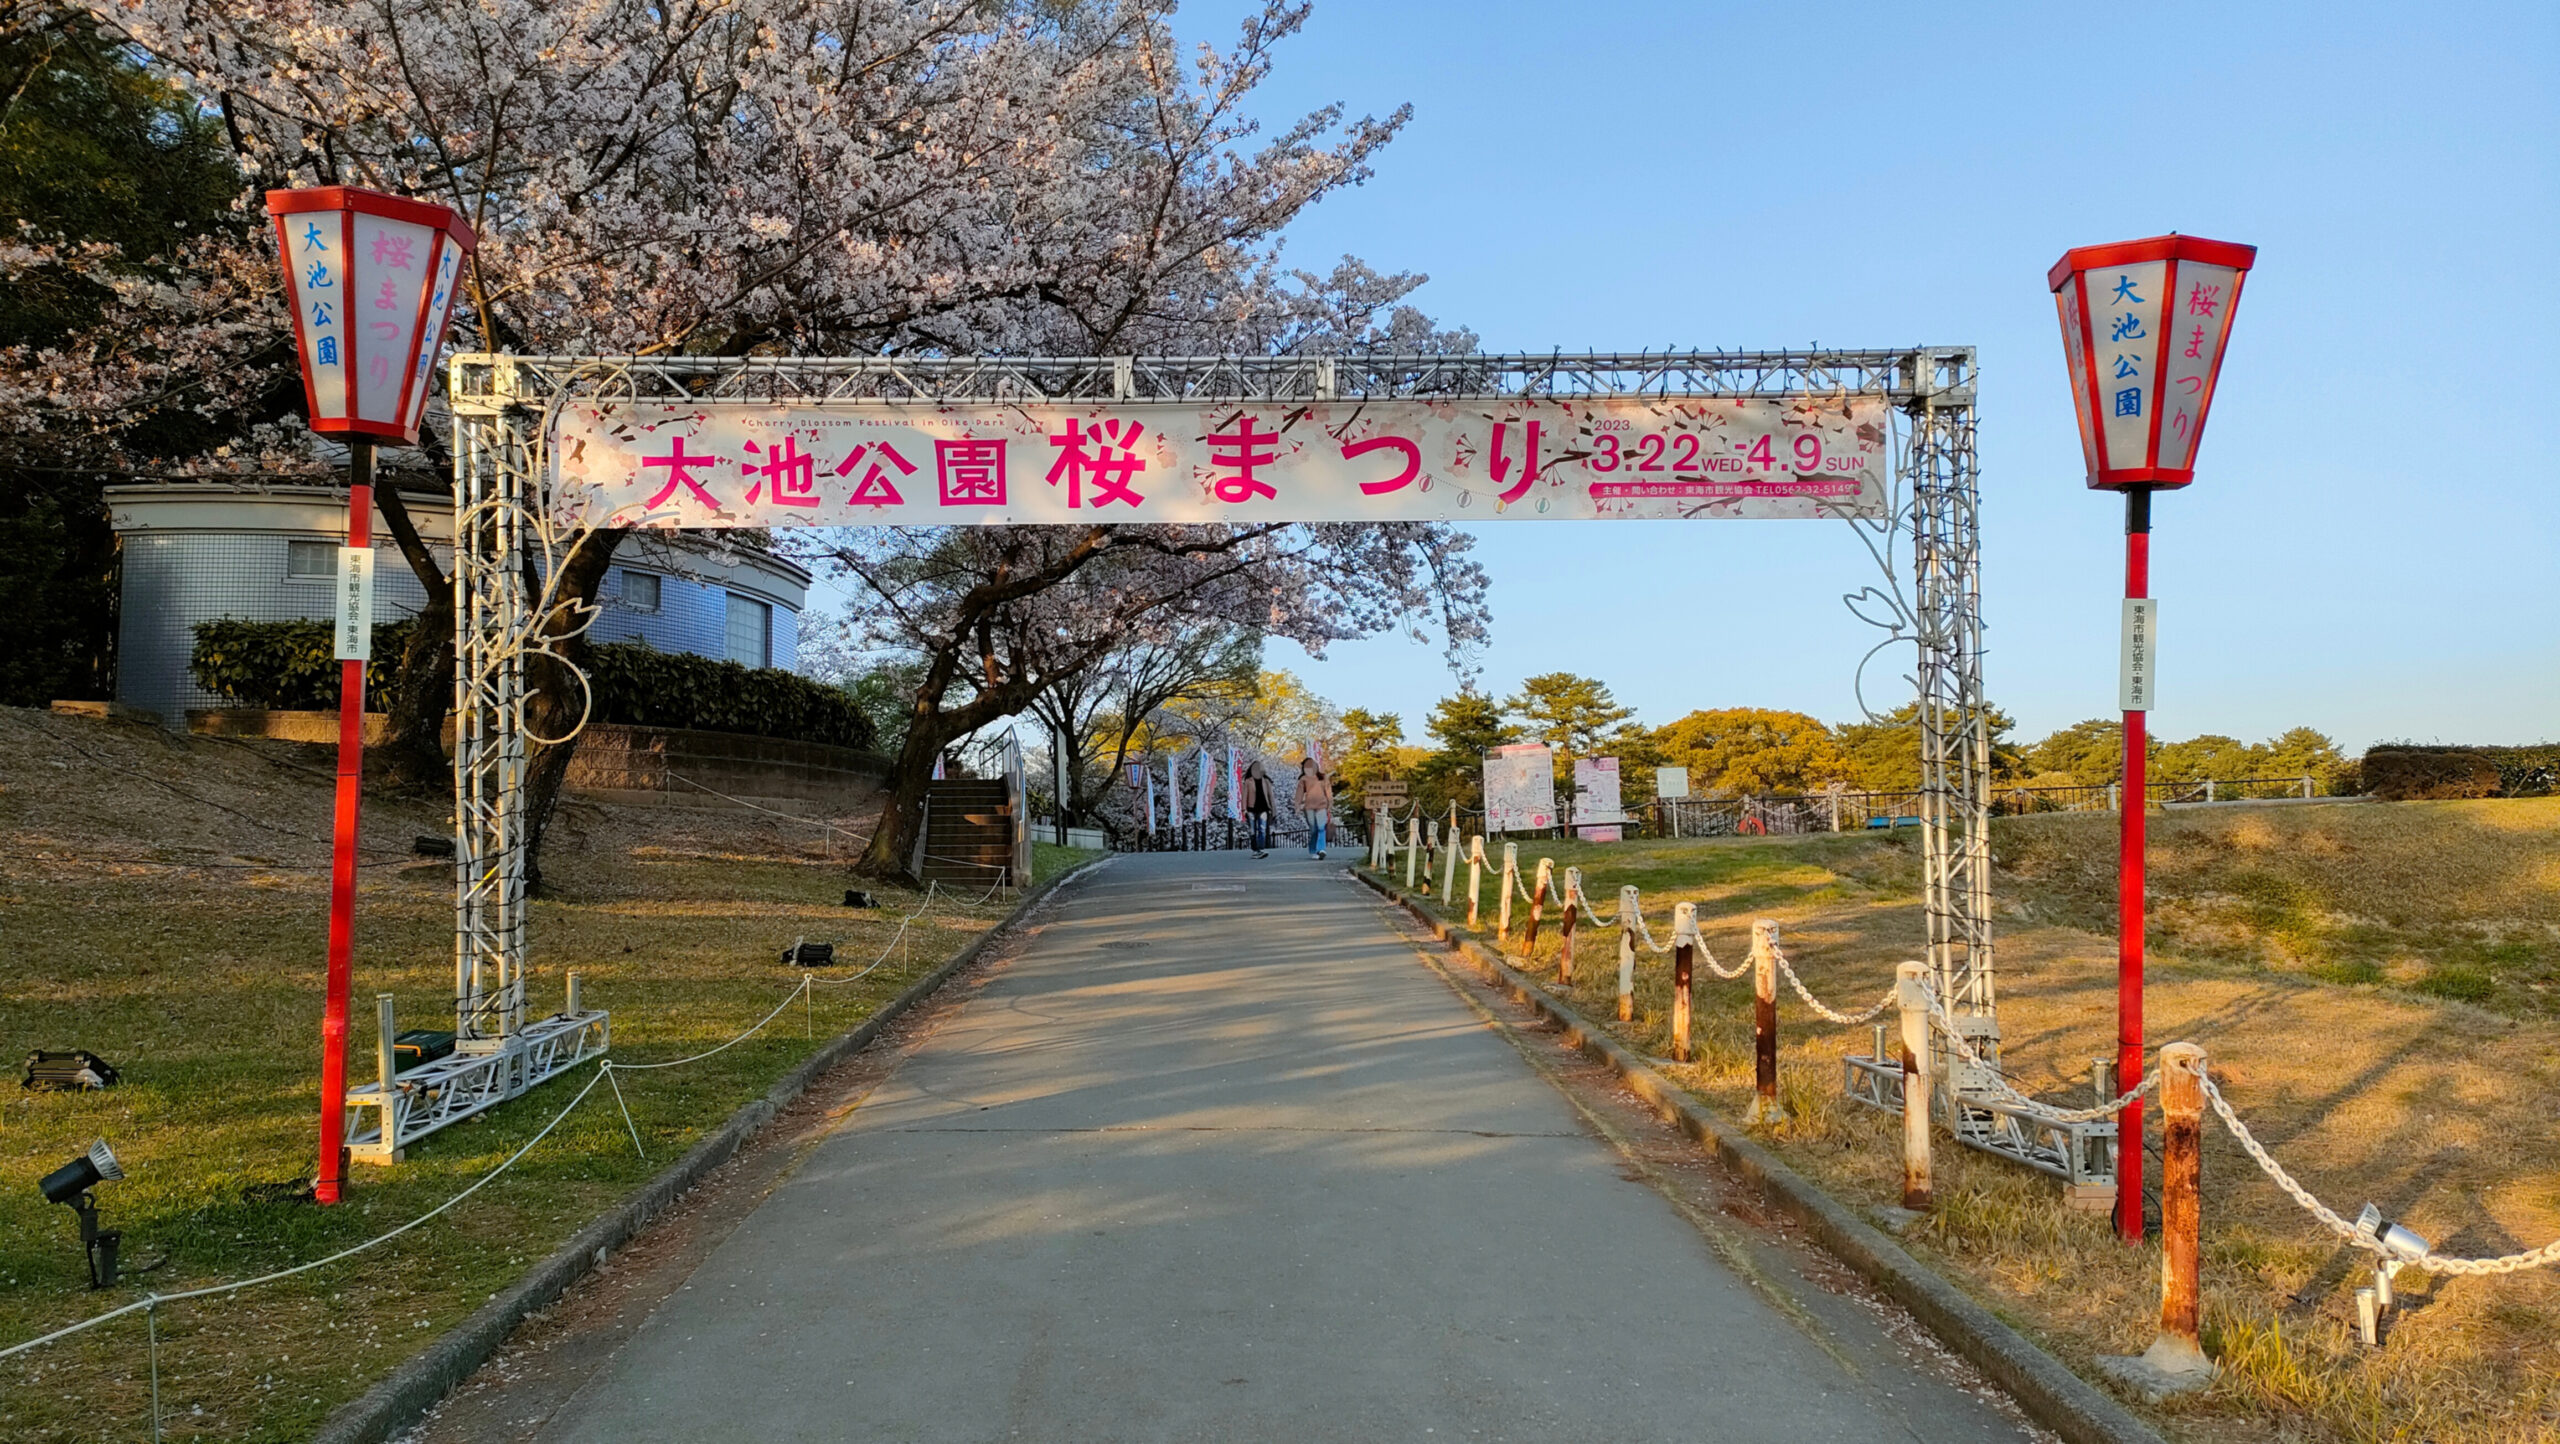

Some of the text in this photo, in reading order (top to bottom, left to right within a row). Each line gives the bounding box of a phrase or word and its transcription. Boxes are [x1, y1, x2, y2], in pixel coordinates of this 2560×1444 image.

[304, 222, 338, 366] 大池公園
[369, 230, 416, 389] 桜まつり
[417, 248, 454, 380] 大池公園
[2110, 275, 2146, 418] 大池公園
[748, 419, 793, 428] Cherry
[801, 419, 852, 427] Blossom
[859, 419, 915, 427] Festival
[941, 419, 969, 427] Oike
[976, 419, 1006, 427] Park
[2172, 281, 2220, 442] 桜まつり
[1592, 434, 1700, 472] 3.22
[1702, 458, 1743, 472] WED
[1825, 457, 1864, 472] SUN
[346, 554, 362, 654] 東海市観光協会・東海市
[2131, 605, 2145, 704] 東海市観光協会・東海市
